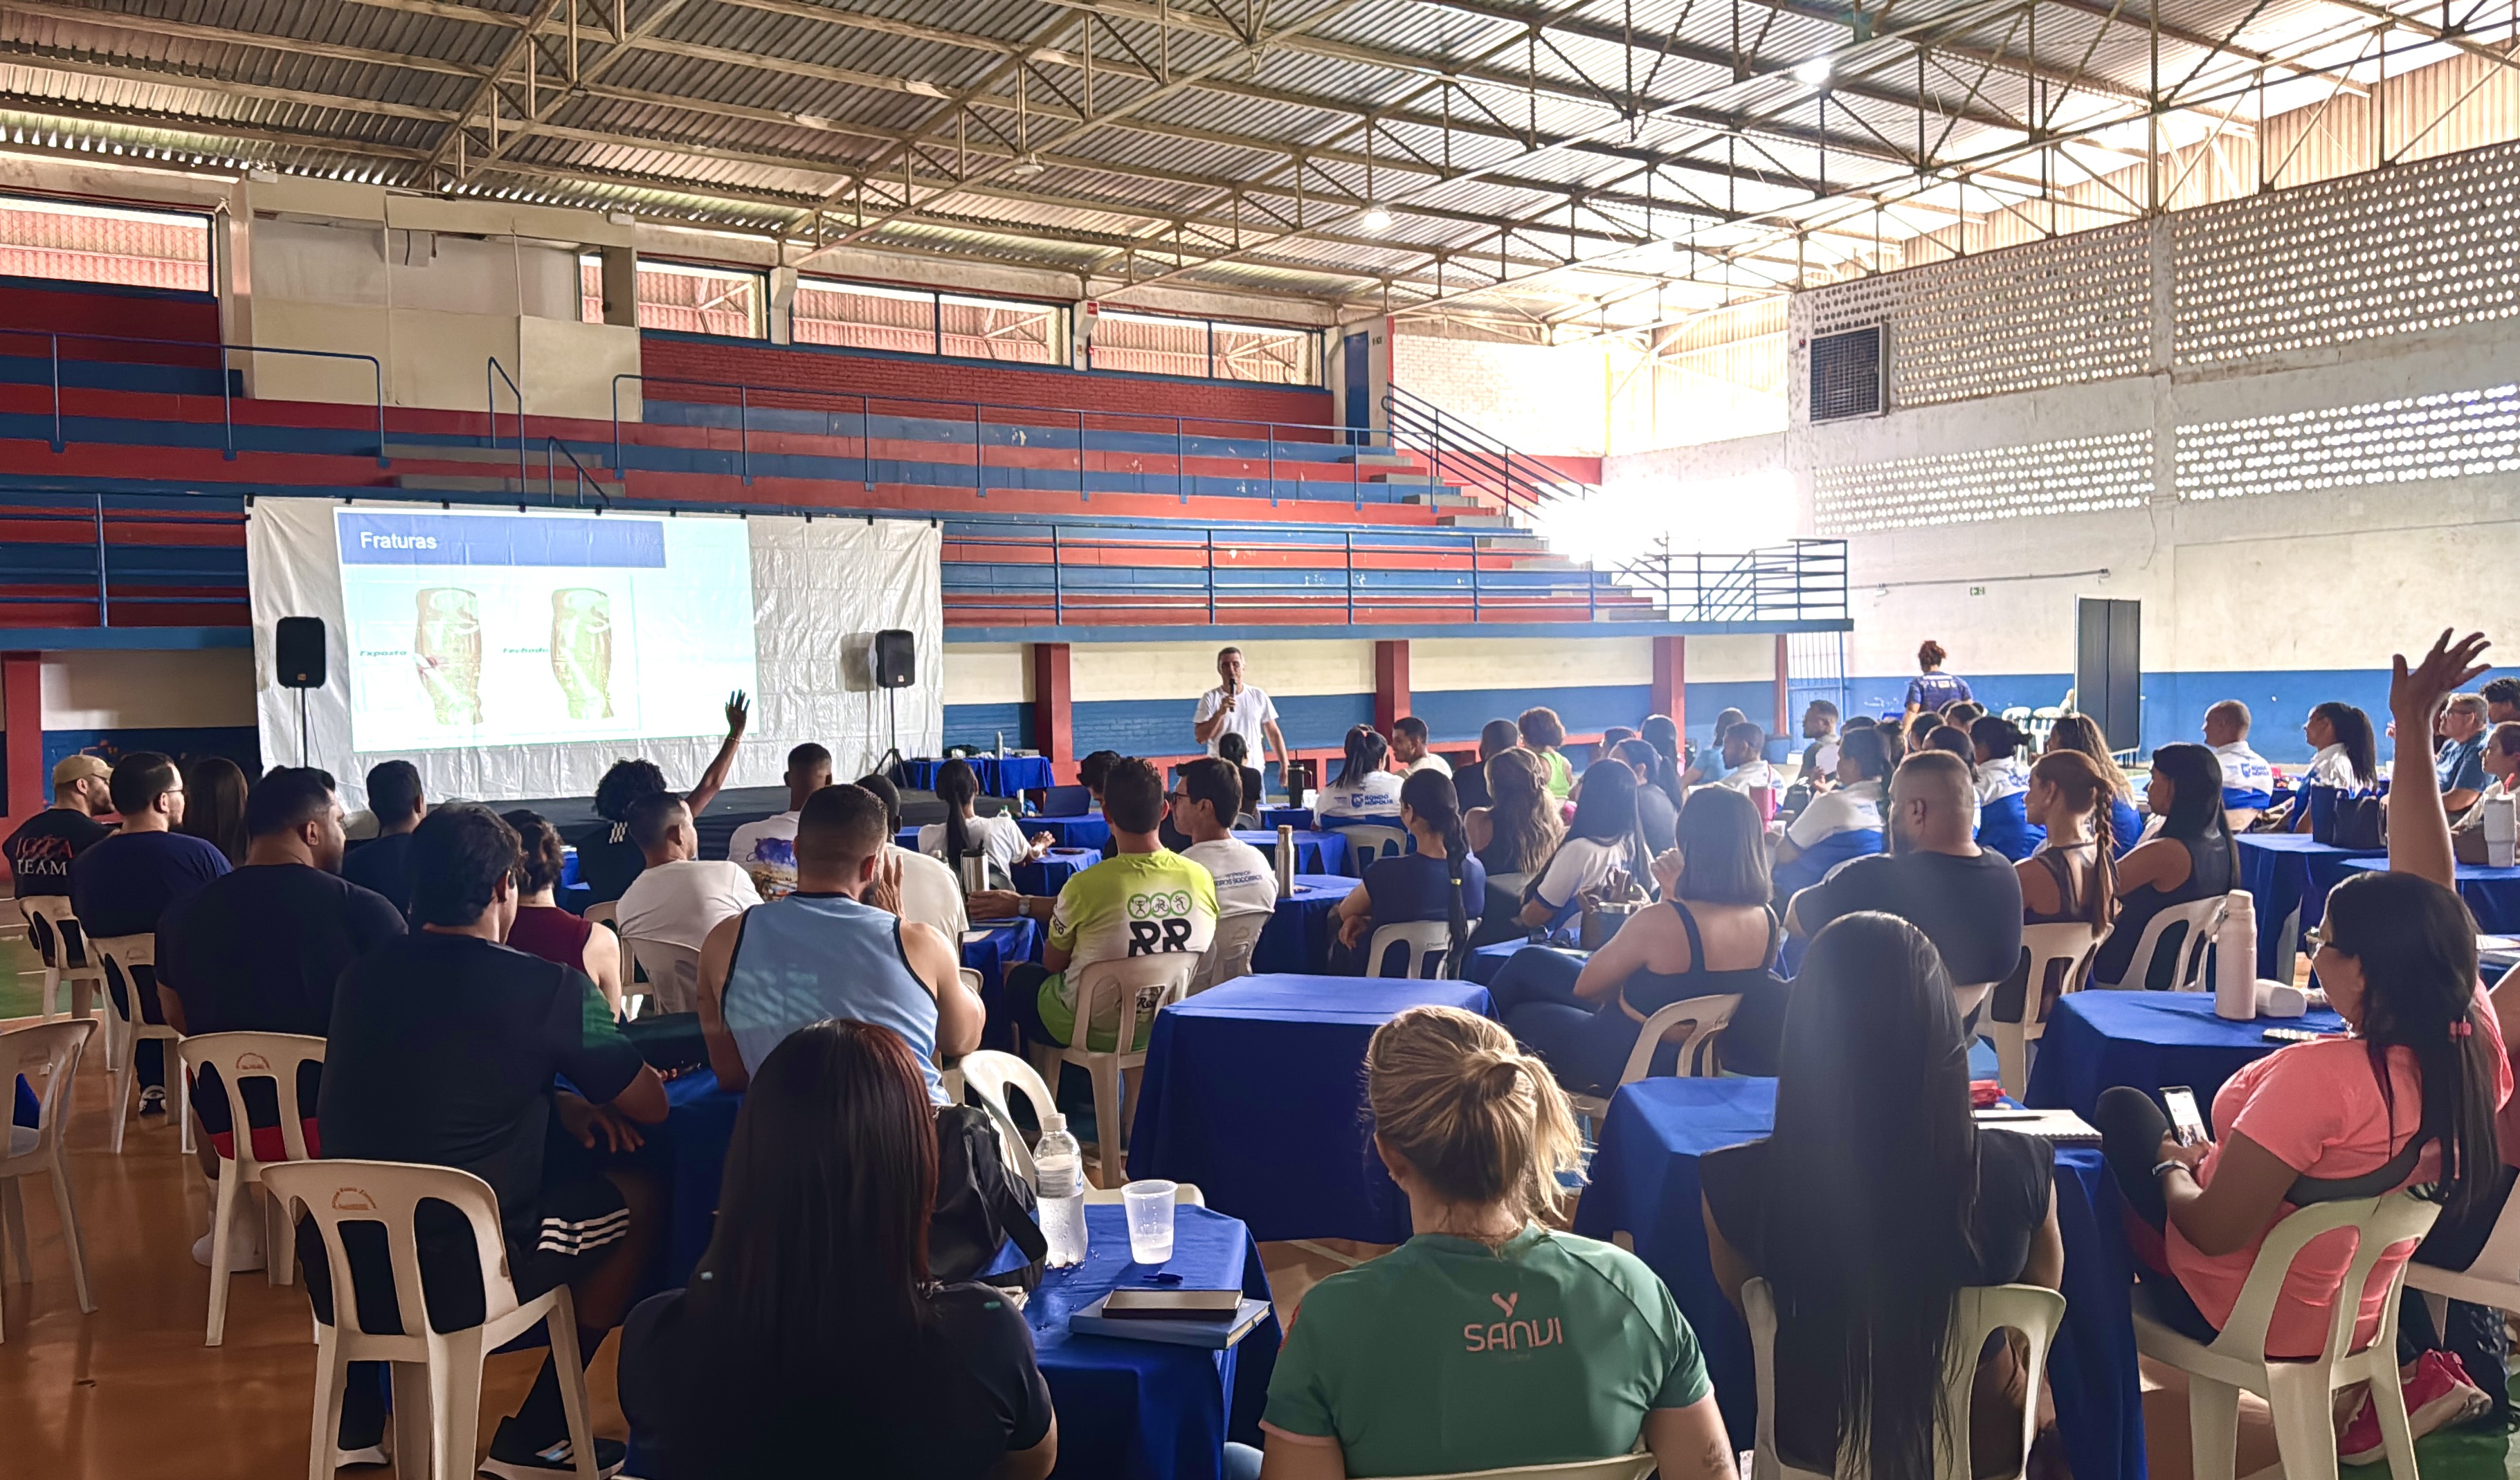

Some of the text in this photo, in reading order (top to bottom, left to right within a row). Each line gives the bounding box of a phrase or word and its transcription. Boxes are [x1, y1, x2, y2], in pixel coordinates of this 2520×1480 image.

[360, 531, 437, 549] Fraturas
[17, 859, 68, 876] TEAM
[1128, 918, 1192, 958] RR
